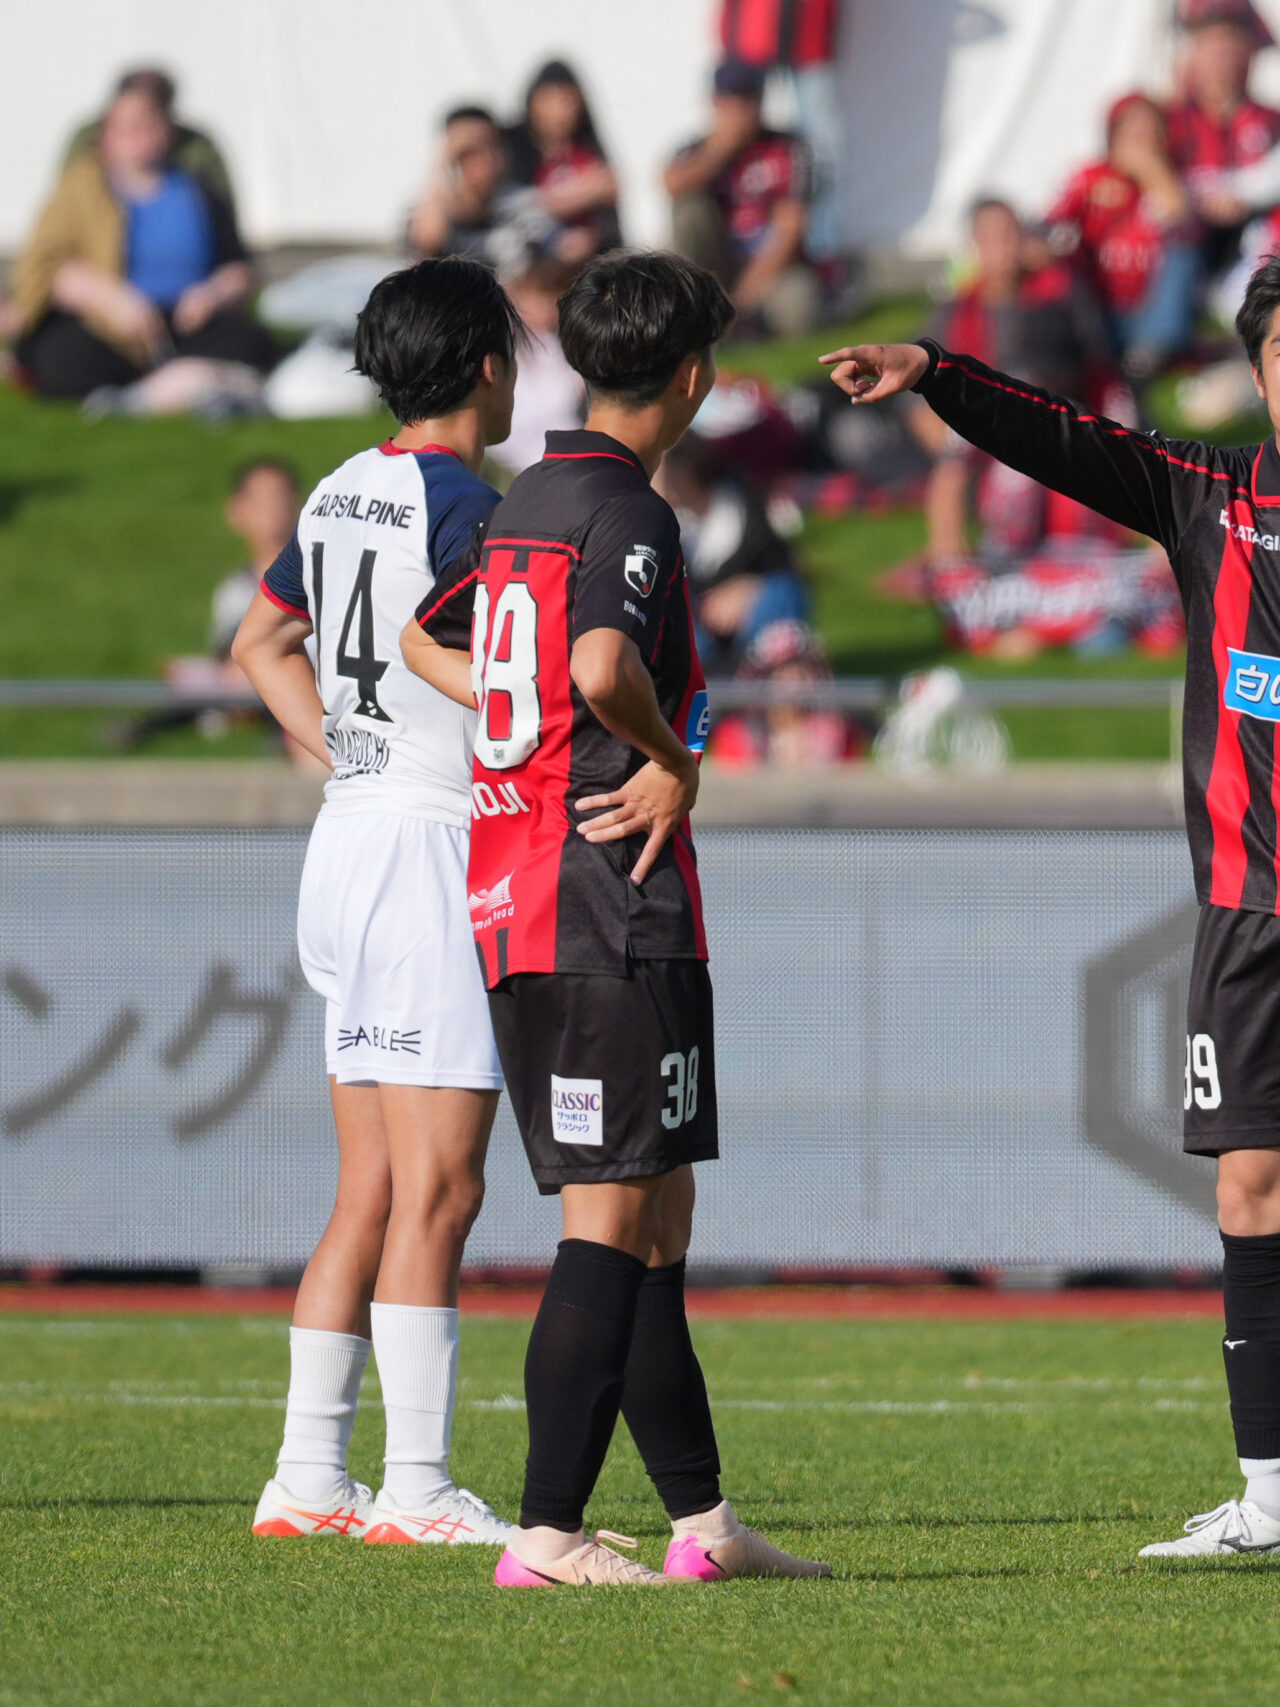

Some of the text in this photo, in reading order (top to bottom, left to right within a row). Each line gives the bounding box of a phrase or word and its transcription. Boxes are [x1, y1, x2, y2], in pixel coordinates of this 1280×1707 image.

[311, 541, 394, 724] 14
[346, 1025, 410, 1053] ABLE
[552, 1089, 600, 1112] CLASSIC
[660, 1045, 699, 1130] 38
